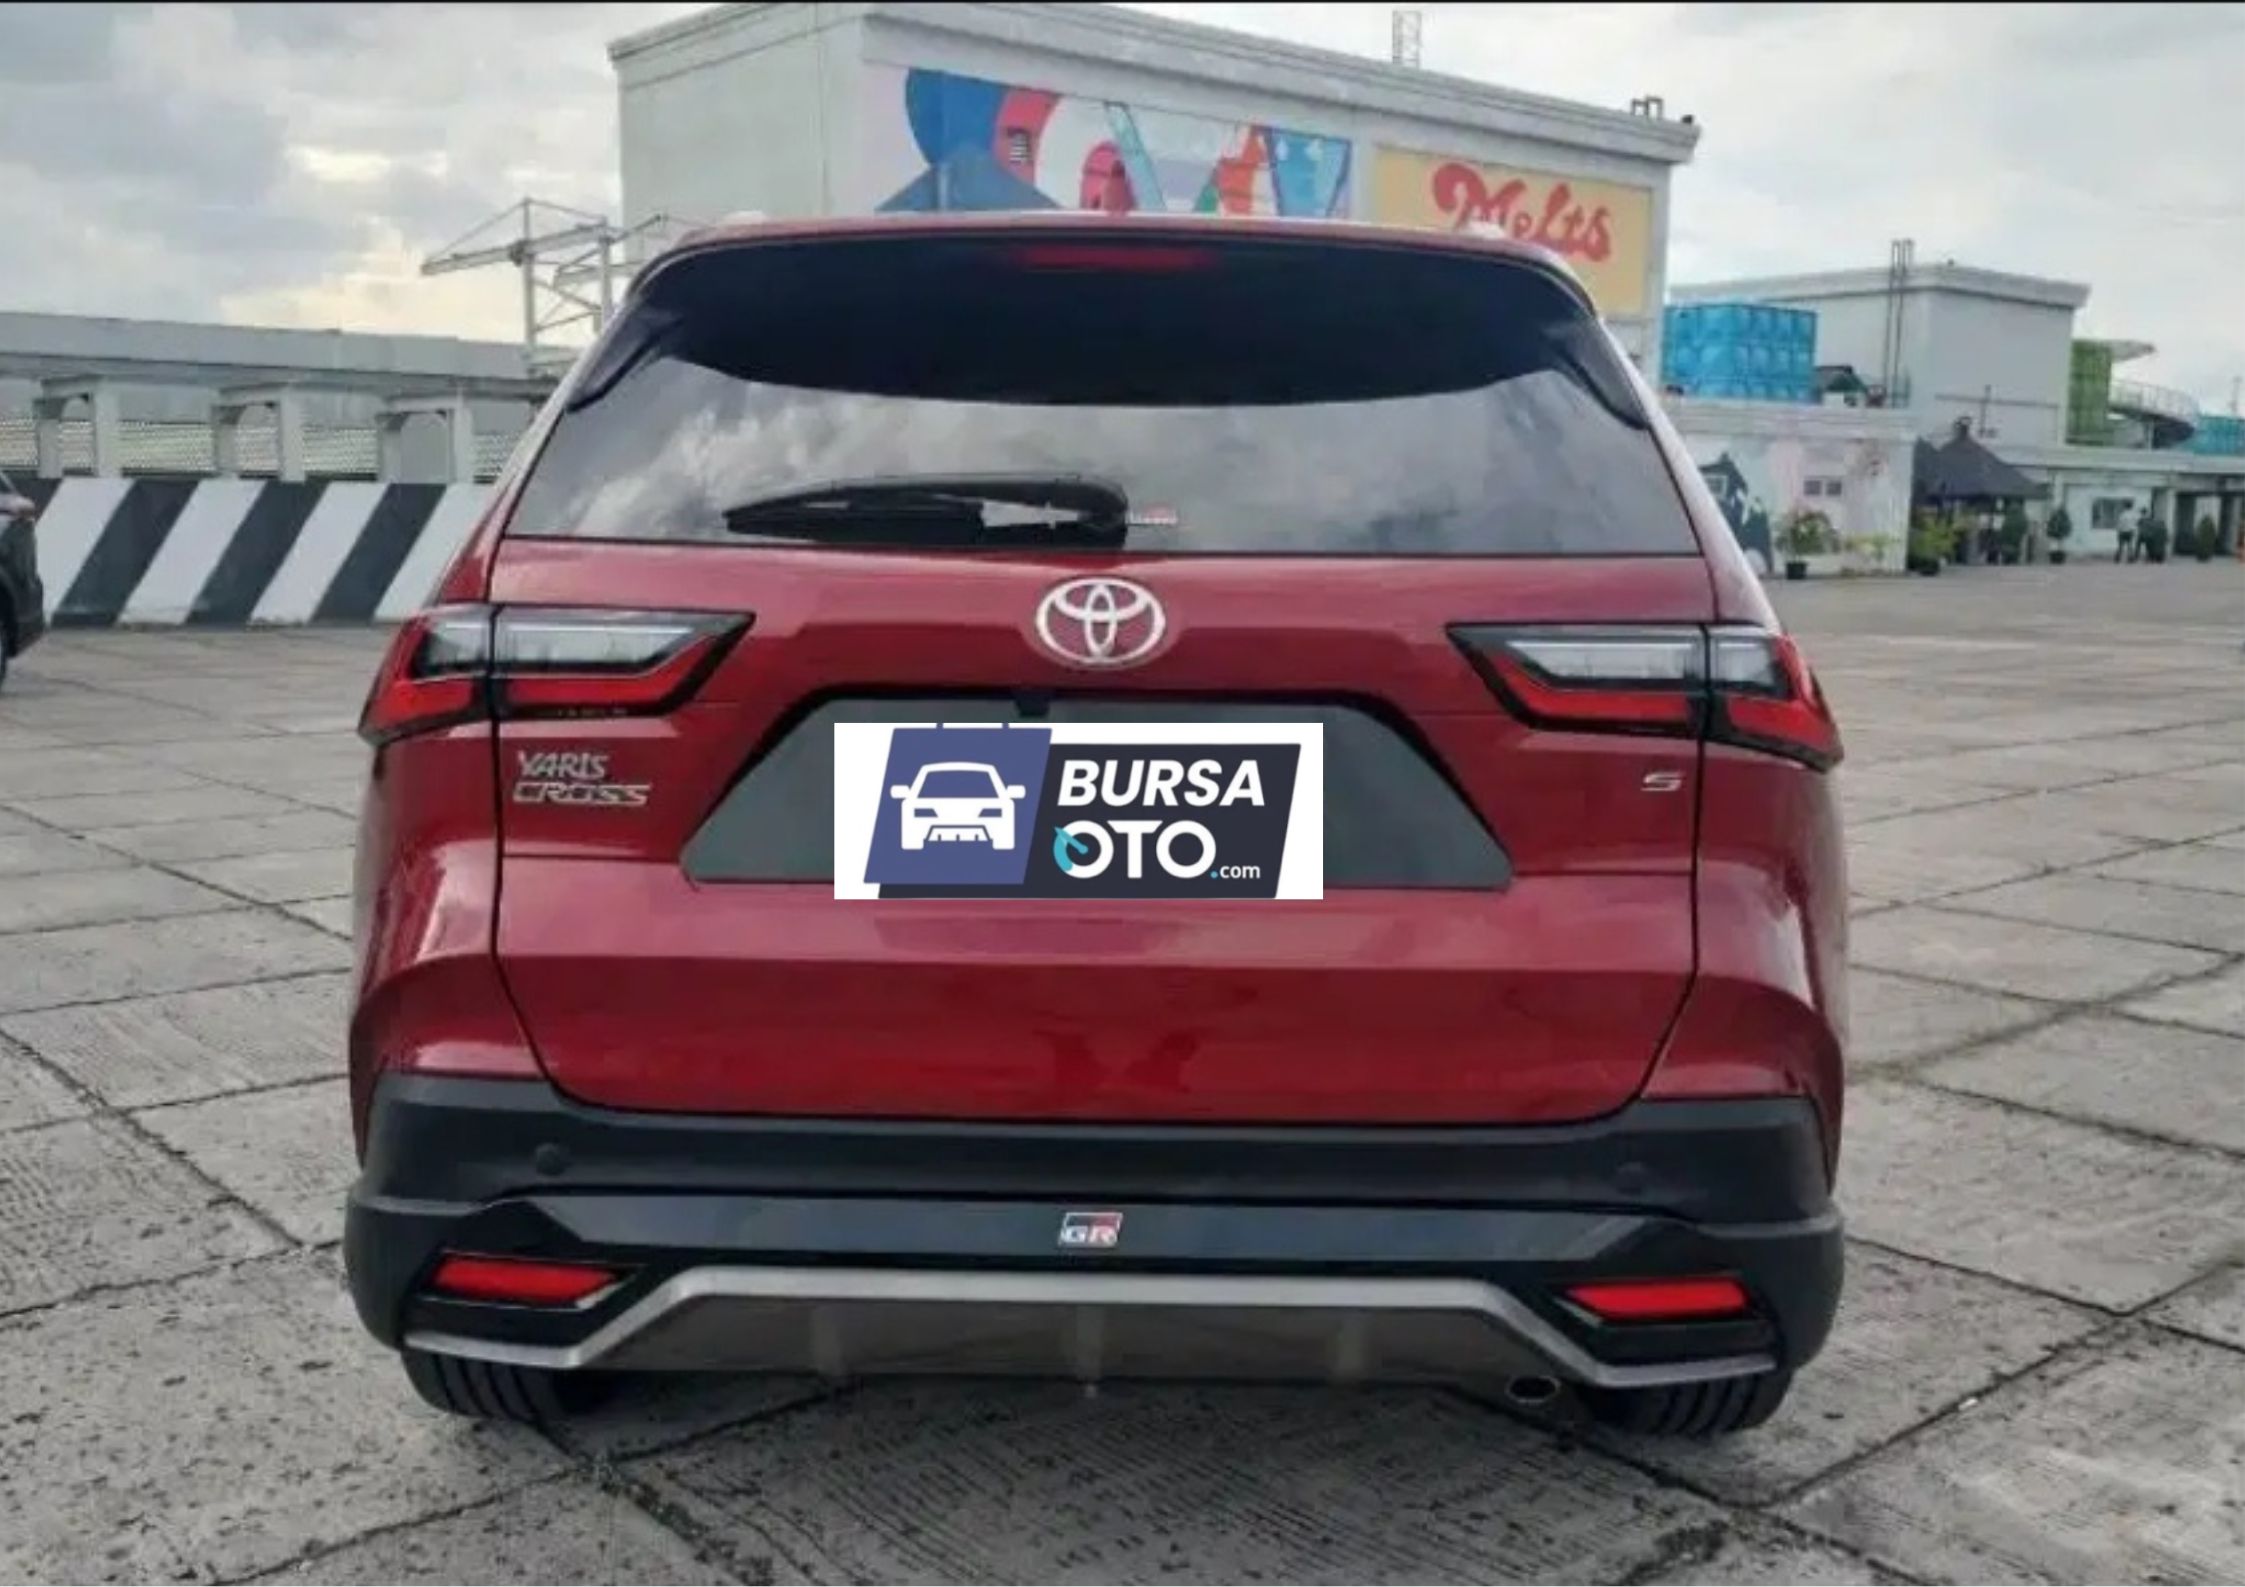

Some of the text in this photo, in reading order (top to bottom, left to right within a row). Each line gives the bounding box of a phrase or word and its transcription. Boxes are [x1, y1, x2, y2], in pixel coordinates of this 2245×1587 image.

[517, 751, 608, 779] YARIS
[513, 781, 651, 806] CROSS
[1641, 772, 1684, 791] S
